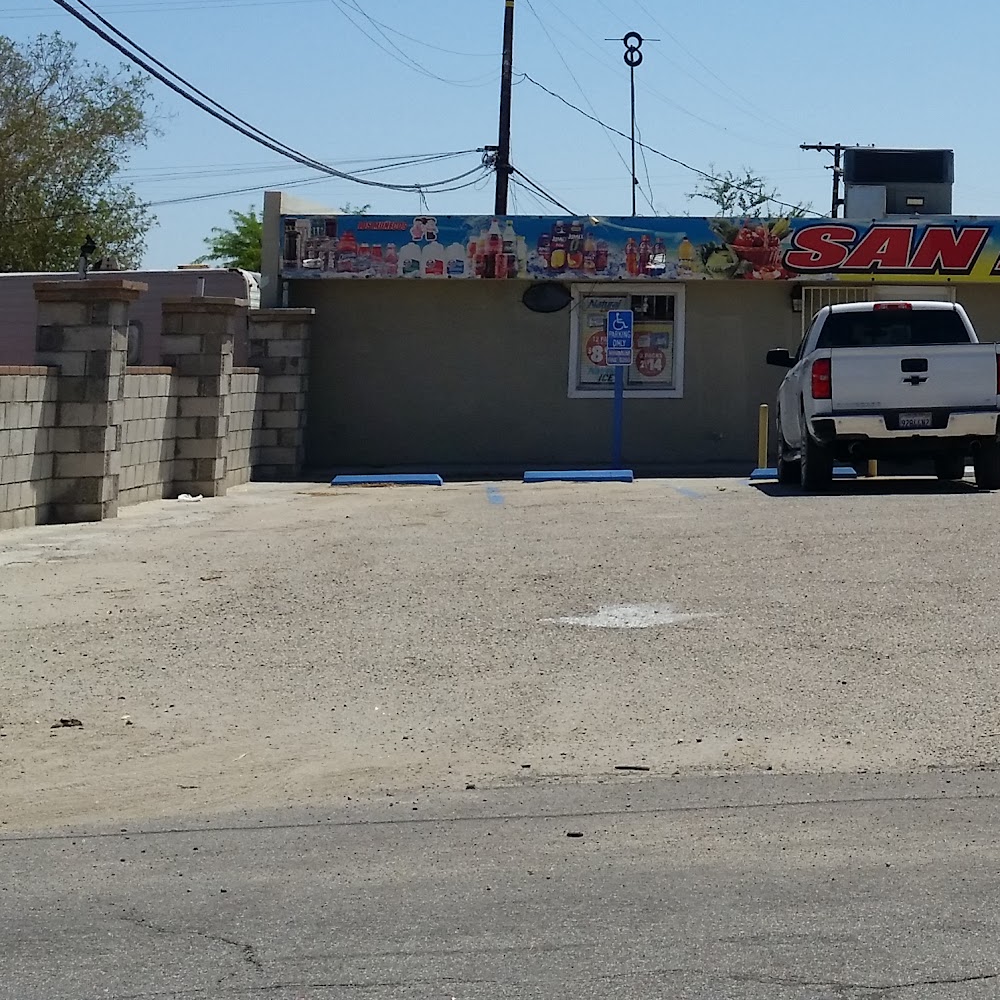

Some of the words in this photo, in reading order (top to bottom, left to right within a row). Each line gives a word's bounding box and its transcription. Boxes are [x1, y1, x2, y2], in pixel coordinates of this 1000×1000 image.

[783, 224, 990, 275] SAN
[609, 330, 632, 339] PARKING
[612, 339, 627, 347] ONLY
[598, 373, 614, 382] ICE
